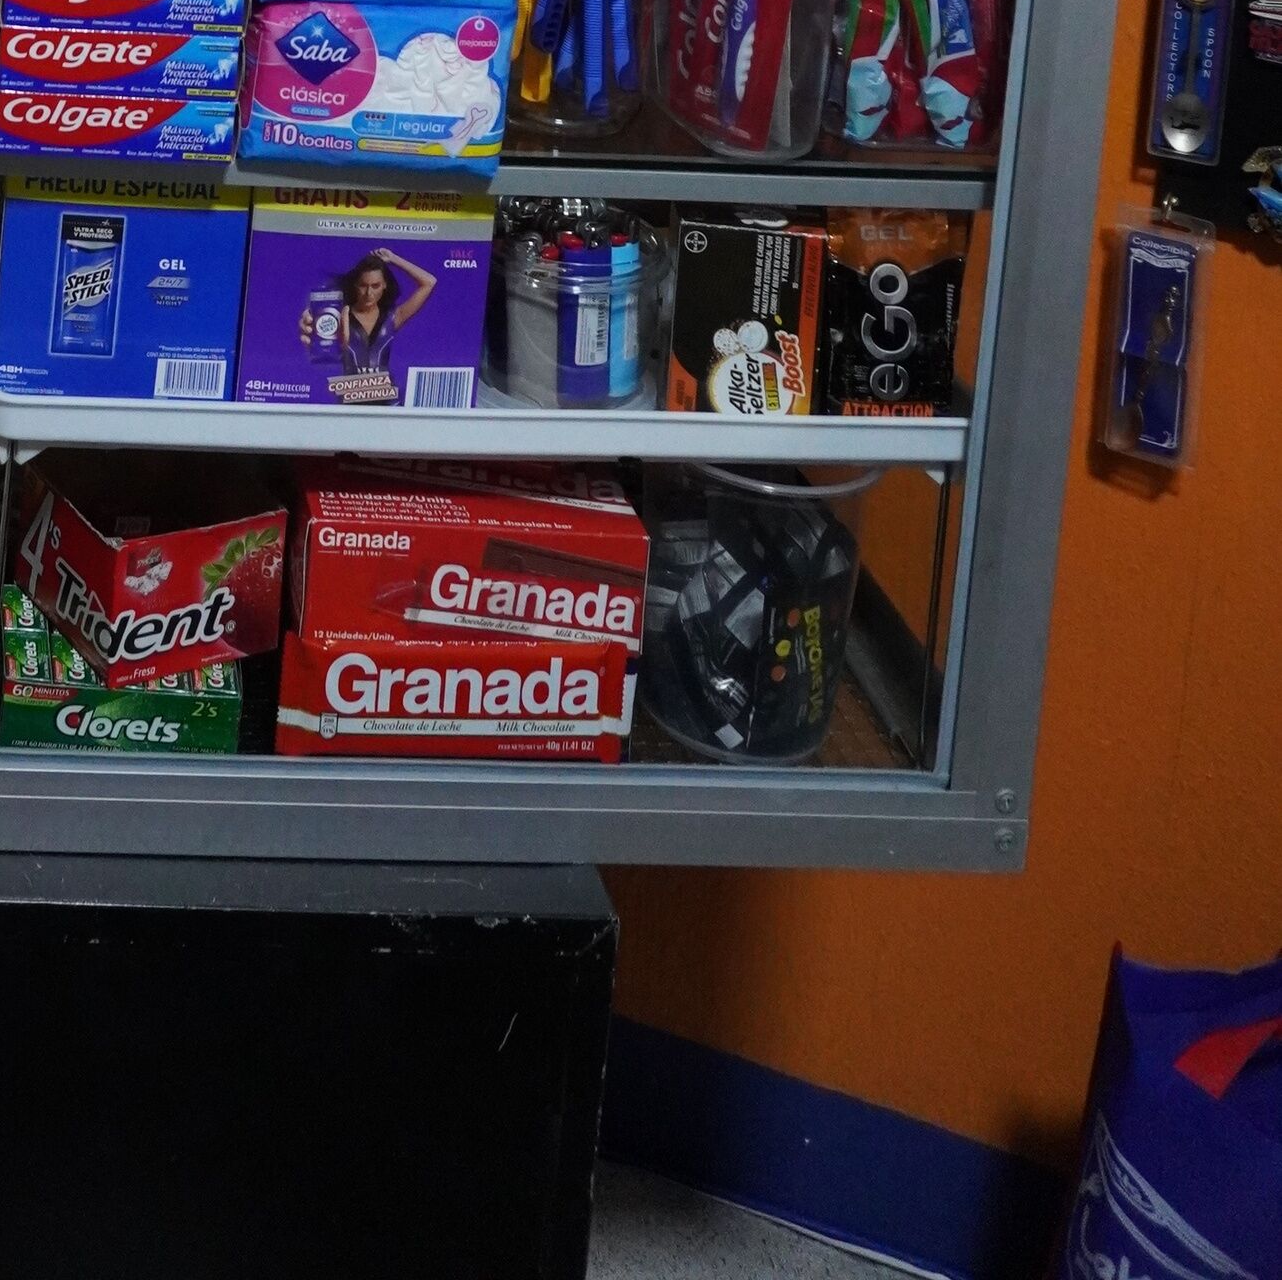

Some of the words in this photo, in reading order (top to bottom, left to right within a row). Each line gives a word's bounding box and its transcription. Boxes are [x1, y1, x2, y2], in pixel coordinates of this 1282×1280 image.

[6, 33, 153, 69] Colgate
[285, 36, 353, 63] Saba
[458, 37, 498, 49] mejorado
[1202, 26, 1217, 80] SPOON
[279, 85, 346, 105] clásica
[2, 96, 149, 132] Colgate
[161, 125, 202, 137] Máximo
[398, 120, 446, 136] regular
[155, 141, 205, 152] Anticaries
[158, 133, 211, 145] Protección
[298, 132, 354, 151] toallas
[317, 220, 346, 229] ULTRA
[349, 222, 373, 230] SECA
[859, 224, 914, 242] GEL
[159, 258, 186, 271] GEL
[443, 259, 478, 269] CREMA
[65, 267, 112, 291] SPEED
[69, 281, 112, 305] STICK
[860, 263, 918, 402] eGo
[775, 330, 807, 398] Boost
[245, 379, 272, 390] 48H
[272, 382, 311, 392] PROTECCIÓN
[329, 376, 392, 392] CONFIANZA
[343, 389, 397, 402] CONTINUA
[318, 491, 336, 499] 12
[338, 493, 453, 505] Unidades/Units
[318, 525, 411, 551] Granada
[430, 563, 636, 633] Granada
[55, 556, 236, 665] Trident
[313, 629, 324, 639] 12
[325, 629, 395, 642] Unidades/Units
[21, 638, 38, 677] Clorets
[133, 664, 157, 680] Fresa
[12, 683, 35, 698] 60
[33, 686, 71, 698] MINUTOS
[324, 652, 600, 716] Granada
[55, 703, 182, 744] Clorets
[363, 720, 415, 733] Chocolate
[416, 721, 430, 733] de
[430, 721, 462, 733] Leche
[495, 721, 520, 733] Milk
[521, 721, 576, 734] Chocolate
[545, 741, 561, 753] 40g
